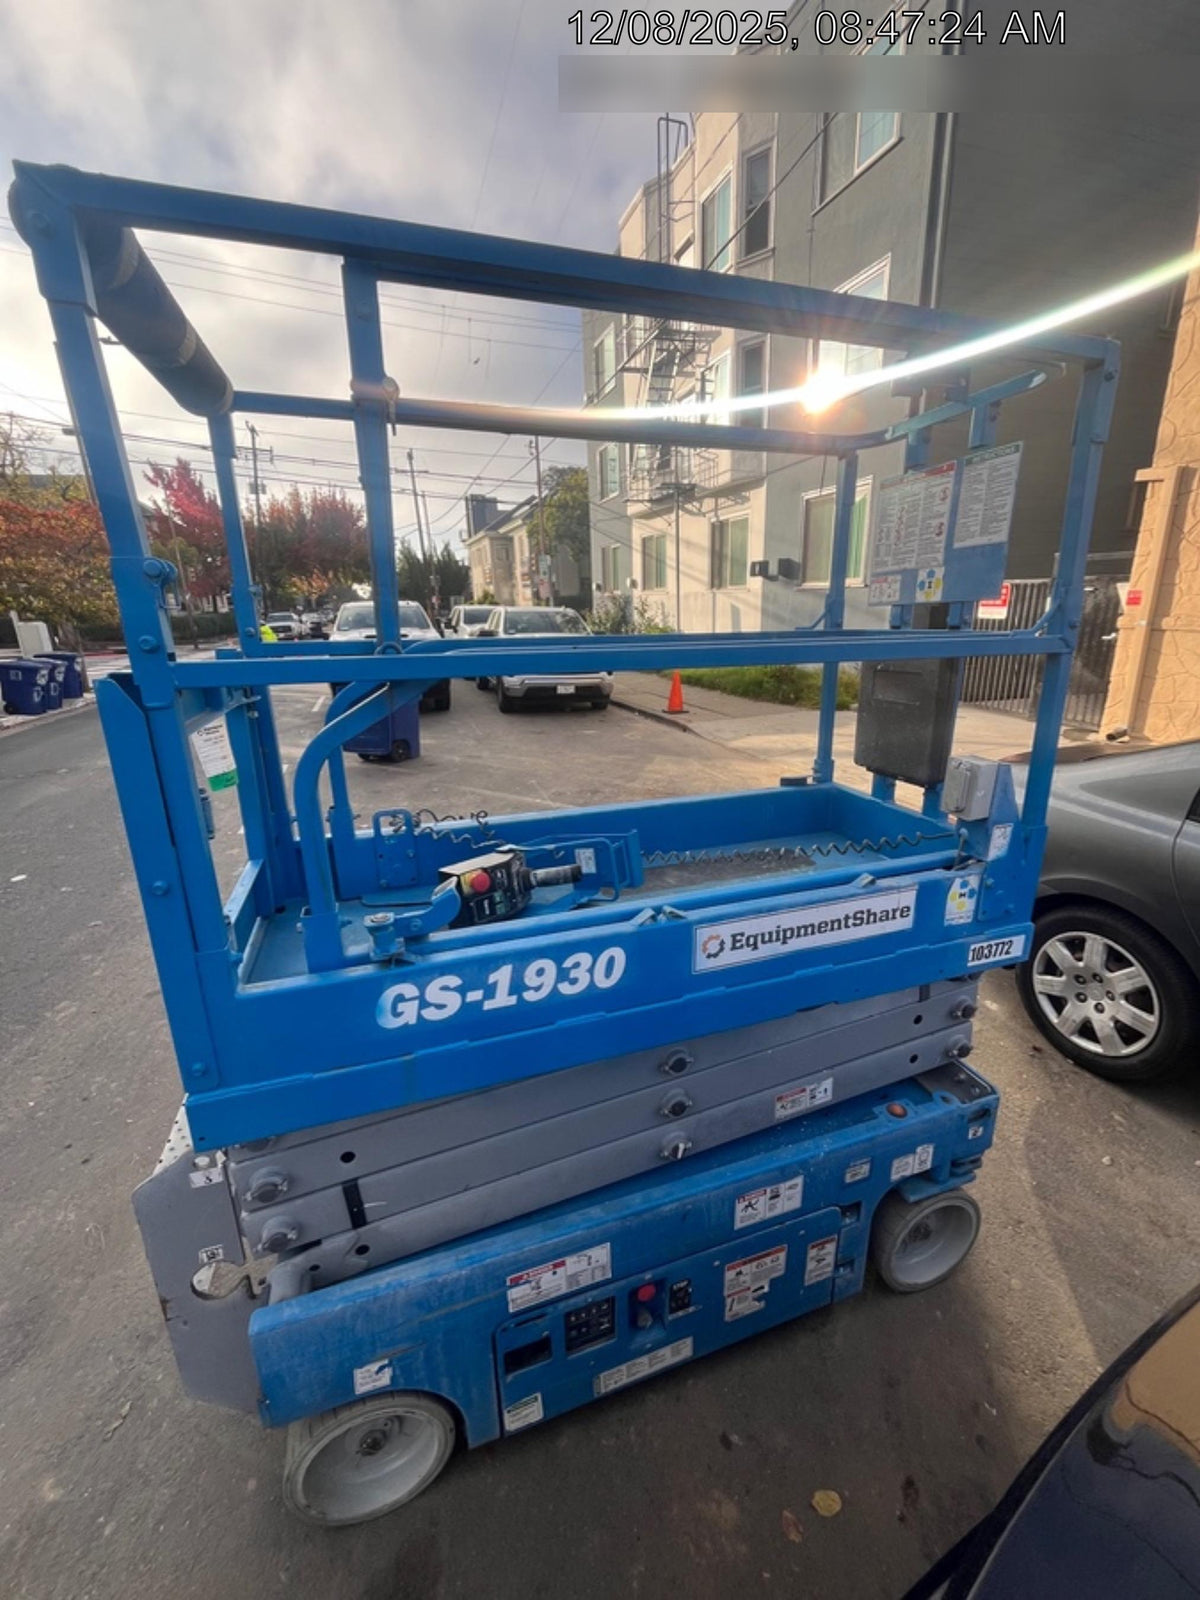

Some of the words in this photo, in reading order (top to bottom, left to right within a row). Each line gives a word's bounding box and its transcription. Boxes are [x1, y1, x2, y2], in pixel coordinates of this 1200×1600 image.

[730, 904, 911, 951] EquipmentShare
[971, 939, 1014, 962] 103772
[376, 946, 627, 1029] GS-1930
